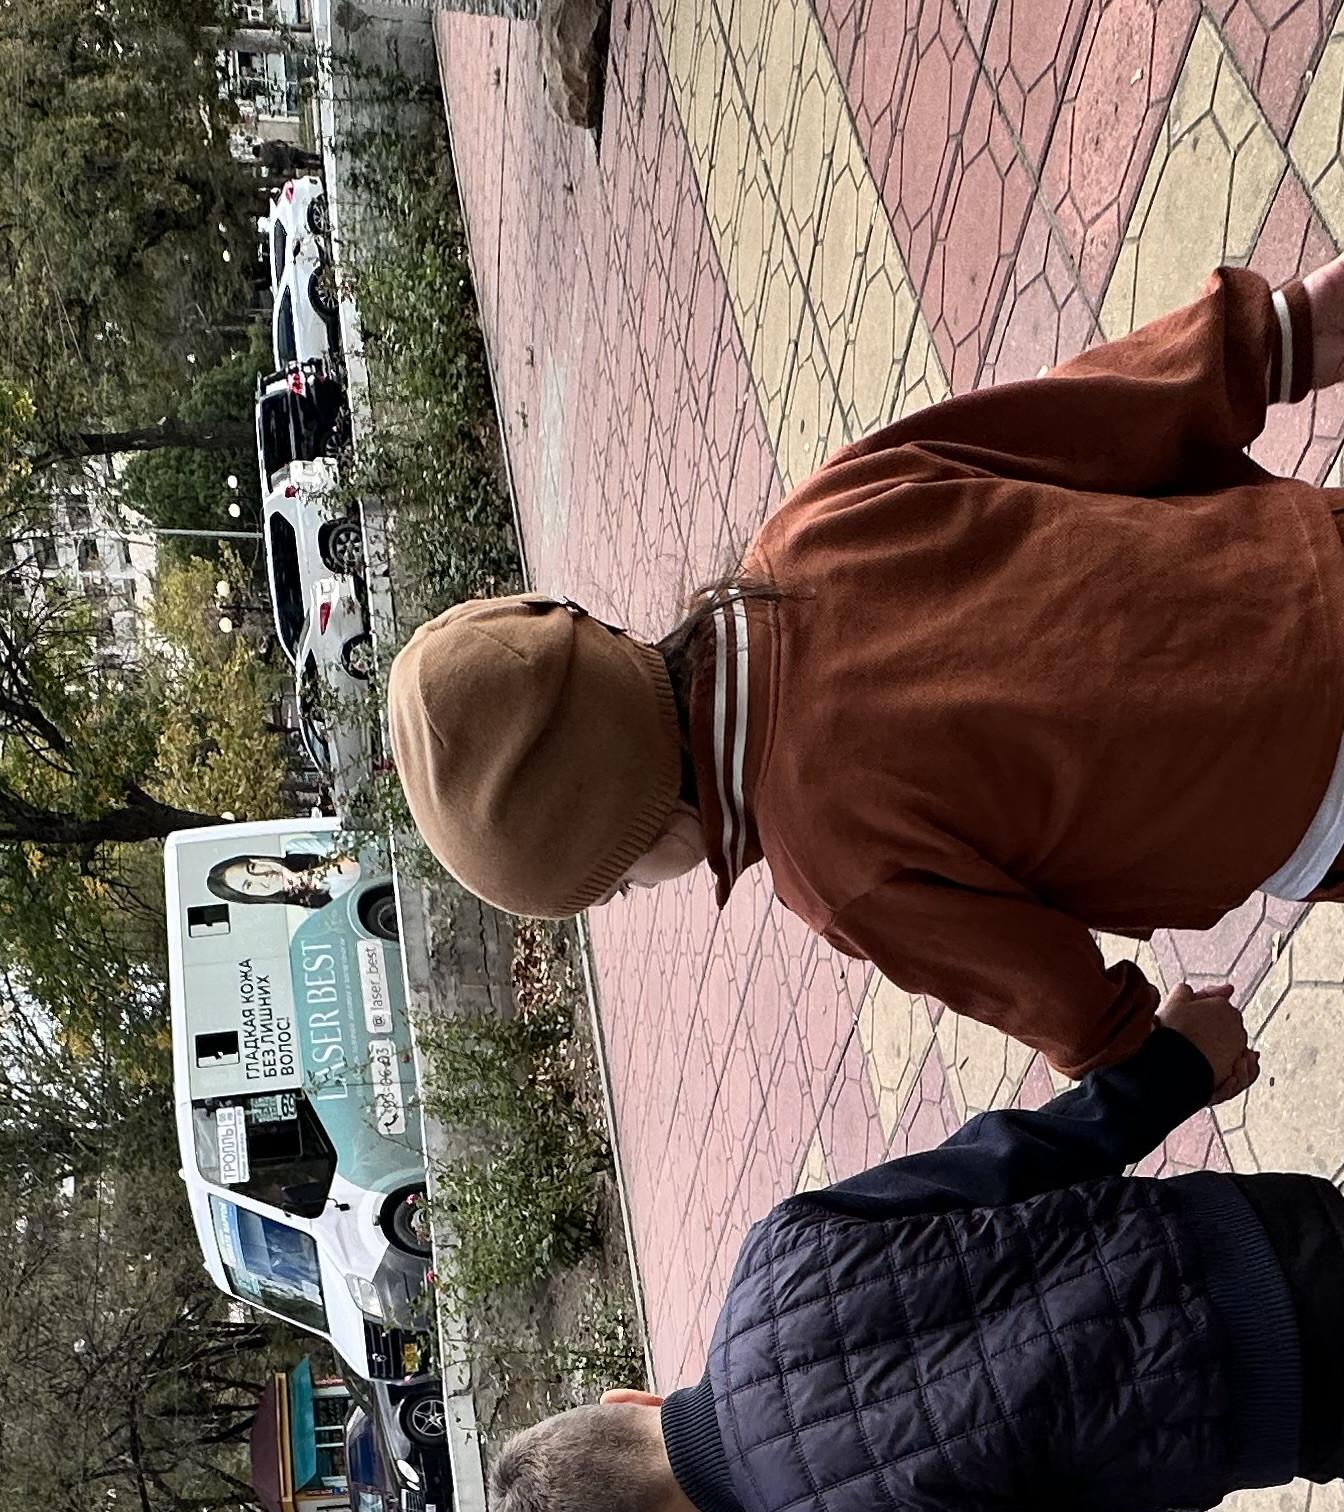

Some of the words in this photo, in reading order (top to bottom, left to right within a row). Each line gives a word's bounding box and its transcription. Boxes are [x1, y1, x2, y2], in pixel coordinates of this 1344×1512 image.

[238, 959, 254, 1004] КОЖА
[300, 939, 338, 1004] BEST
[364, 946, 384, 1010] laser_best
[256, 975, 275, 1045] ЛИШНИХ
[242, 1009, 260, 1080] ГЛАДКАЯ
[261, 1049, 277, 1078] БЕЗ
[276, 1016, 294, 1076] ВОЛОС!
[308, 1009, 349, 1101] LASER
[220, 1128, 237, 1180] ТРОЛЛЬ
